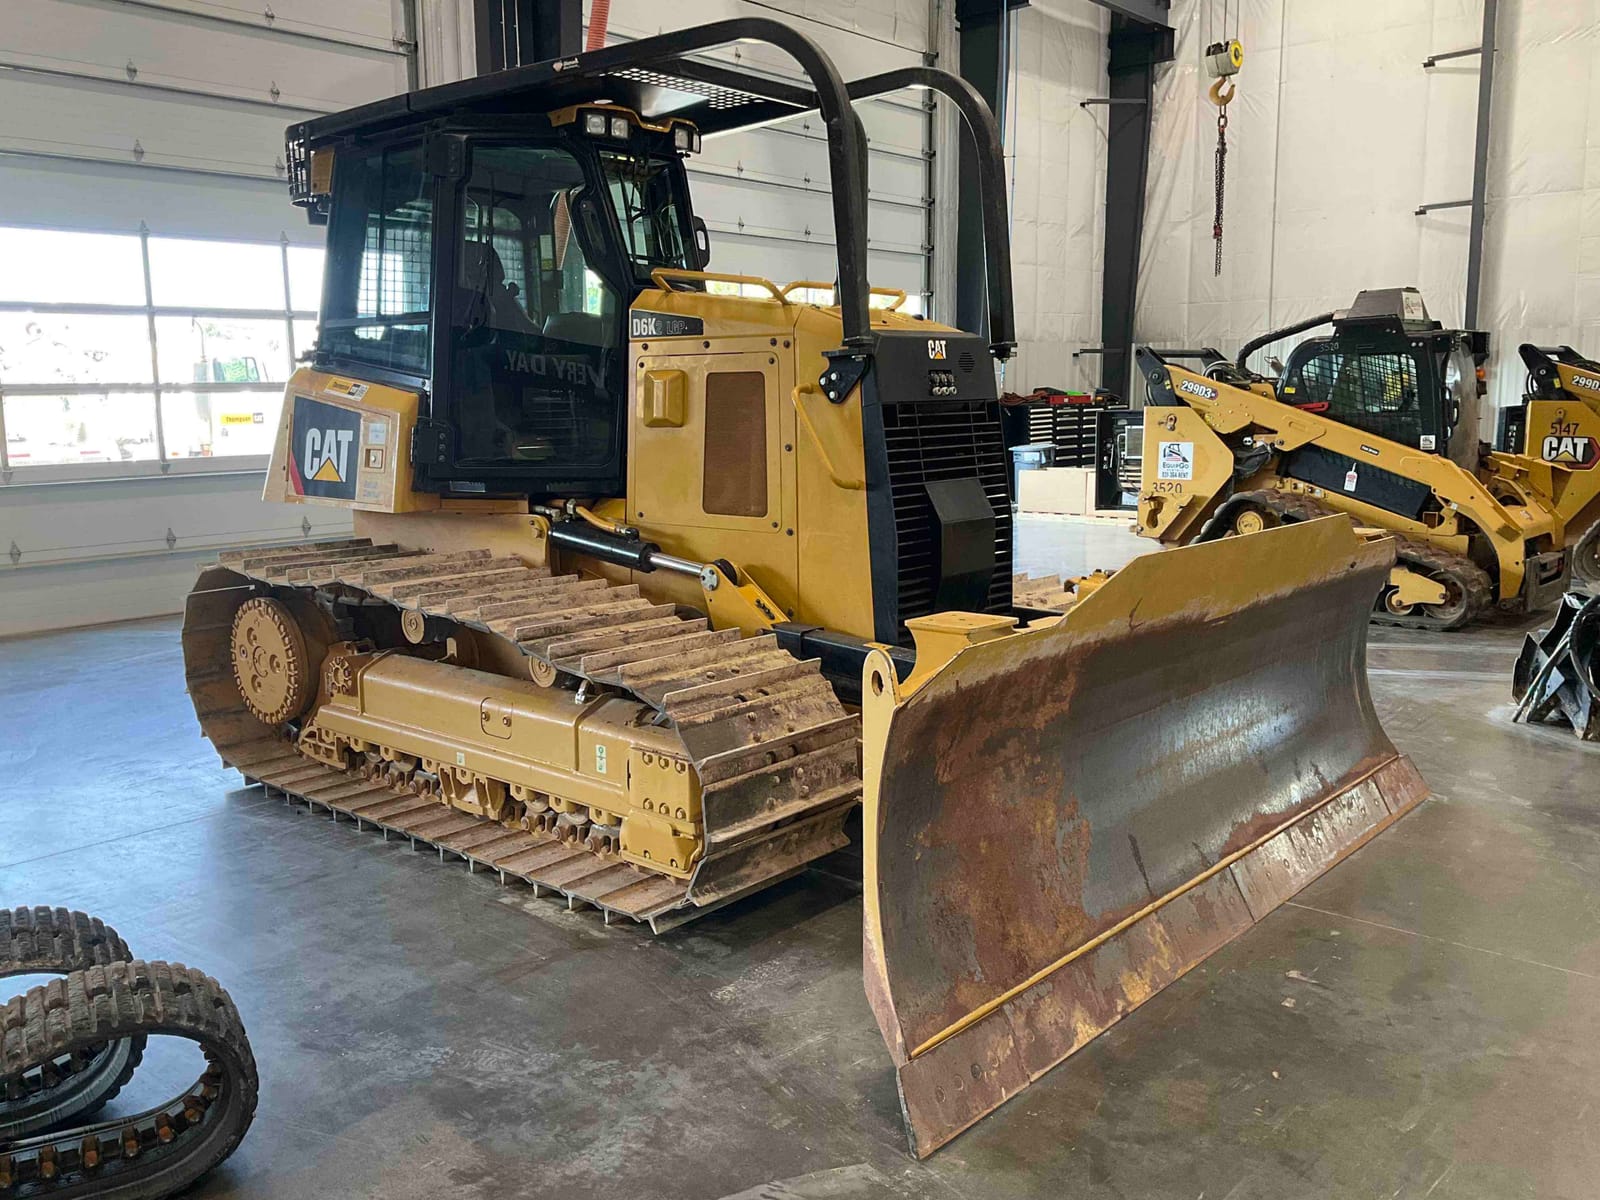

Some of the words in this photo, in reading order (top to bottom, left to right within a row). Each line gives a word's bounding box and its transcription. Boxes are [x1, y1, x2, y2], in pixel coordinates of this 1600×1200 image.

[928, 339, 947, 359] CAT
[1180, 380, 1212, 398] 299D3
[1550, 422, 1580, 435] 5147
[304, 427, 354, 483] CAT
[1543, 436, 1589, 462] CAT
[1152, 482, 1183, 494] 3520
